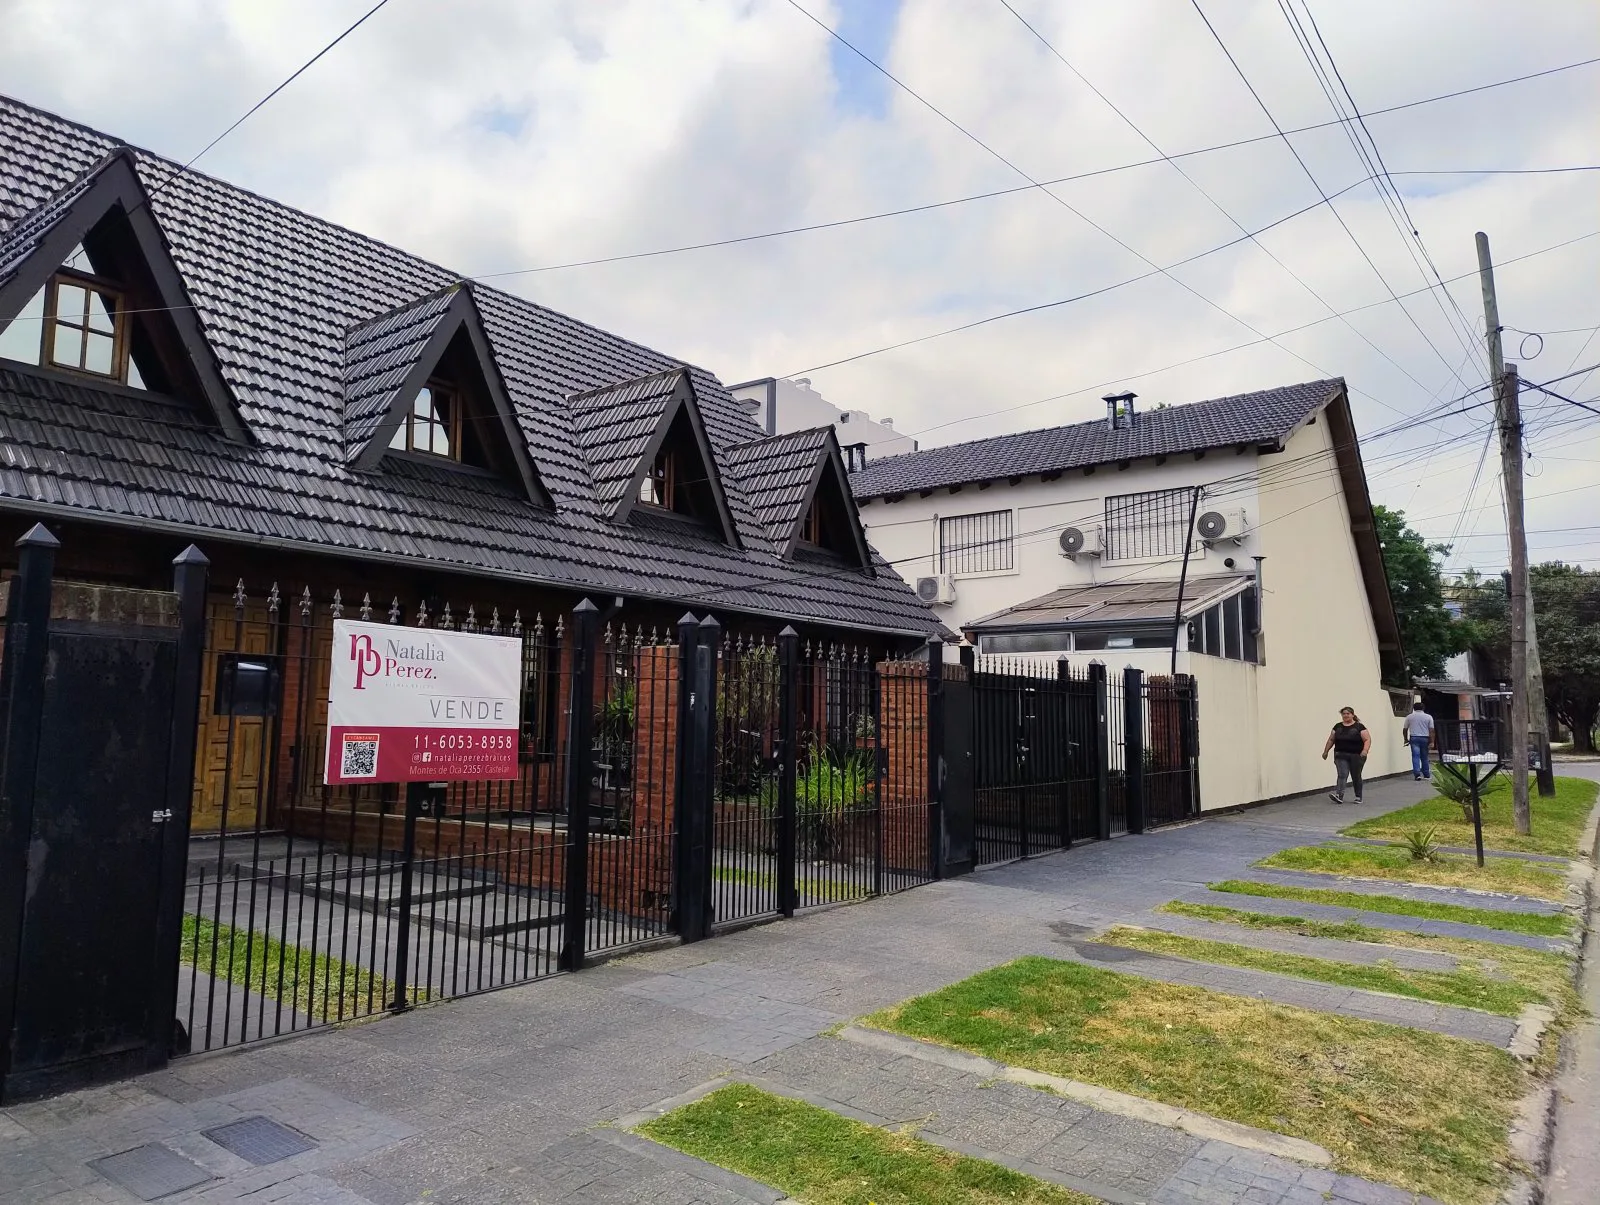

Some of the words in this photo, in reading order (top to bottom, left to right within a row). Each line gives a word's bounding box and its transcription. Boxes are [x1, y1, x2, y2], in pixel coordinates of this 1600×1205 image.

[385, 638, 445, 662] Natalia
[384, 657, 437, 680] Perez.
[430, 699, 503, 720] VENDE
[414, 734, 512, 749] 11-6053-8958
[434, 753, 511, 763] nataliaperezbraices
[409, 766, 437, 775] Montes
[438, 765, 448, 774] de
[449, 766, 462, 774] Oca
